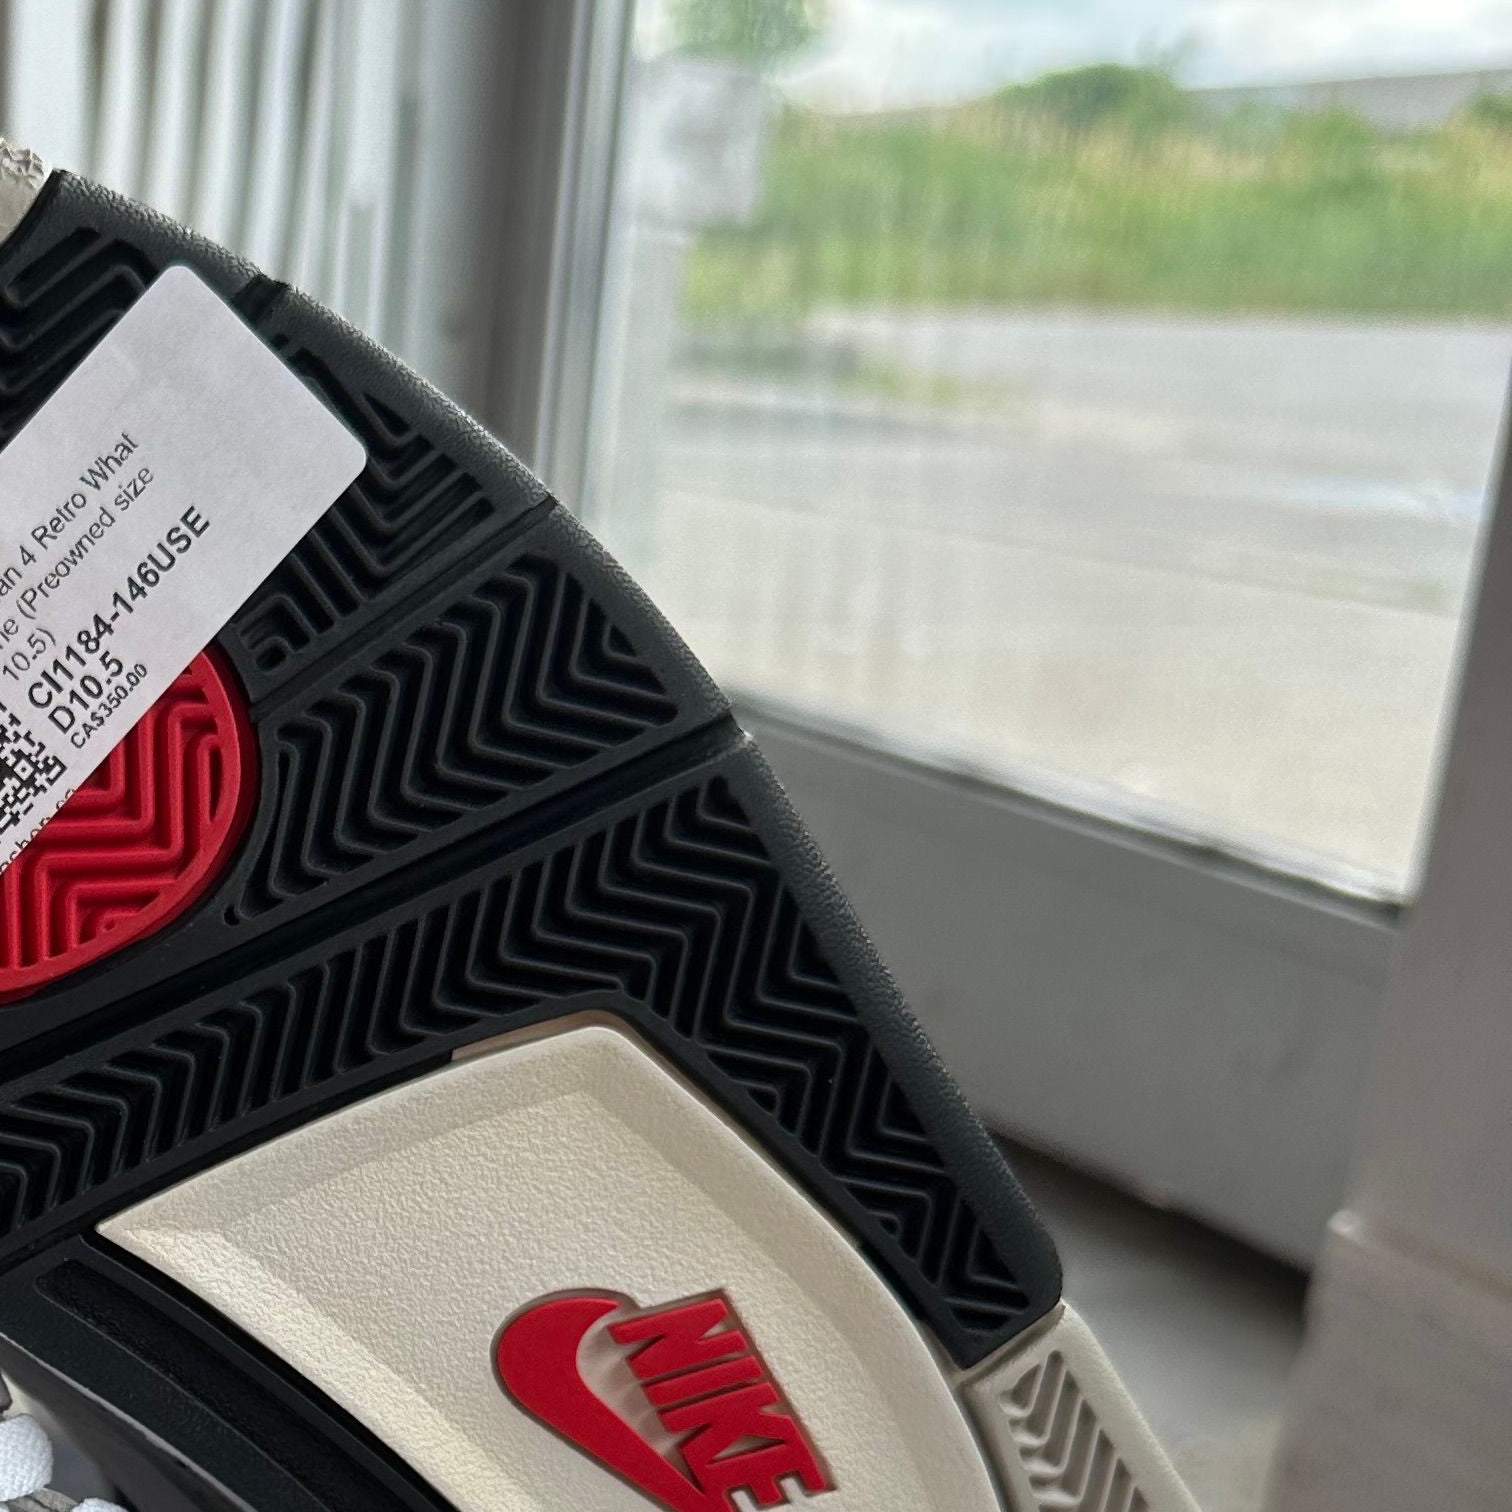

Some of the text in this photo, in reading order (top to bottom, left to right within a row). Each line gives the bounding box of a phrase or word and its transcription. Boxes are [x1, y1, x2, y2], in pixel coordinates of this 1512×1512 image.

[15, 505, 117, 620] (Preowned
[113, 466, 154, 511] size
[19, 544, 37, 566] 4
[31, 492, 87, 550] Retro
[79, 431, 138, 491] What
[2, 627, 57, 681] 10.5)
[27, 505, 211, 710] CI1184-146USE
[47, 650, 124, 735] D10.5
[70, 663, 148, 749] CA$350.00
